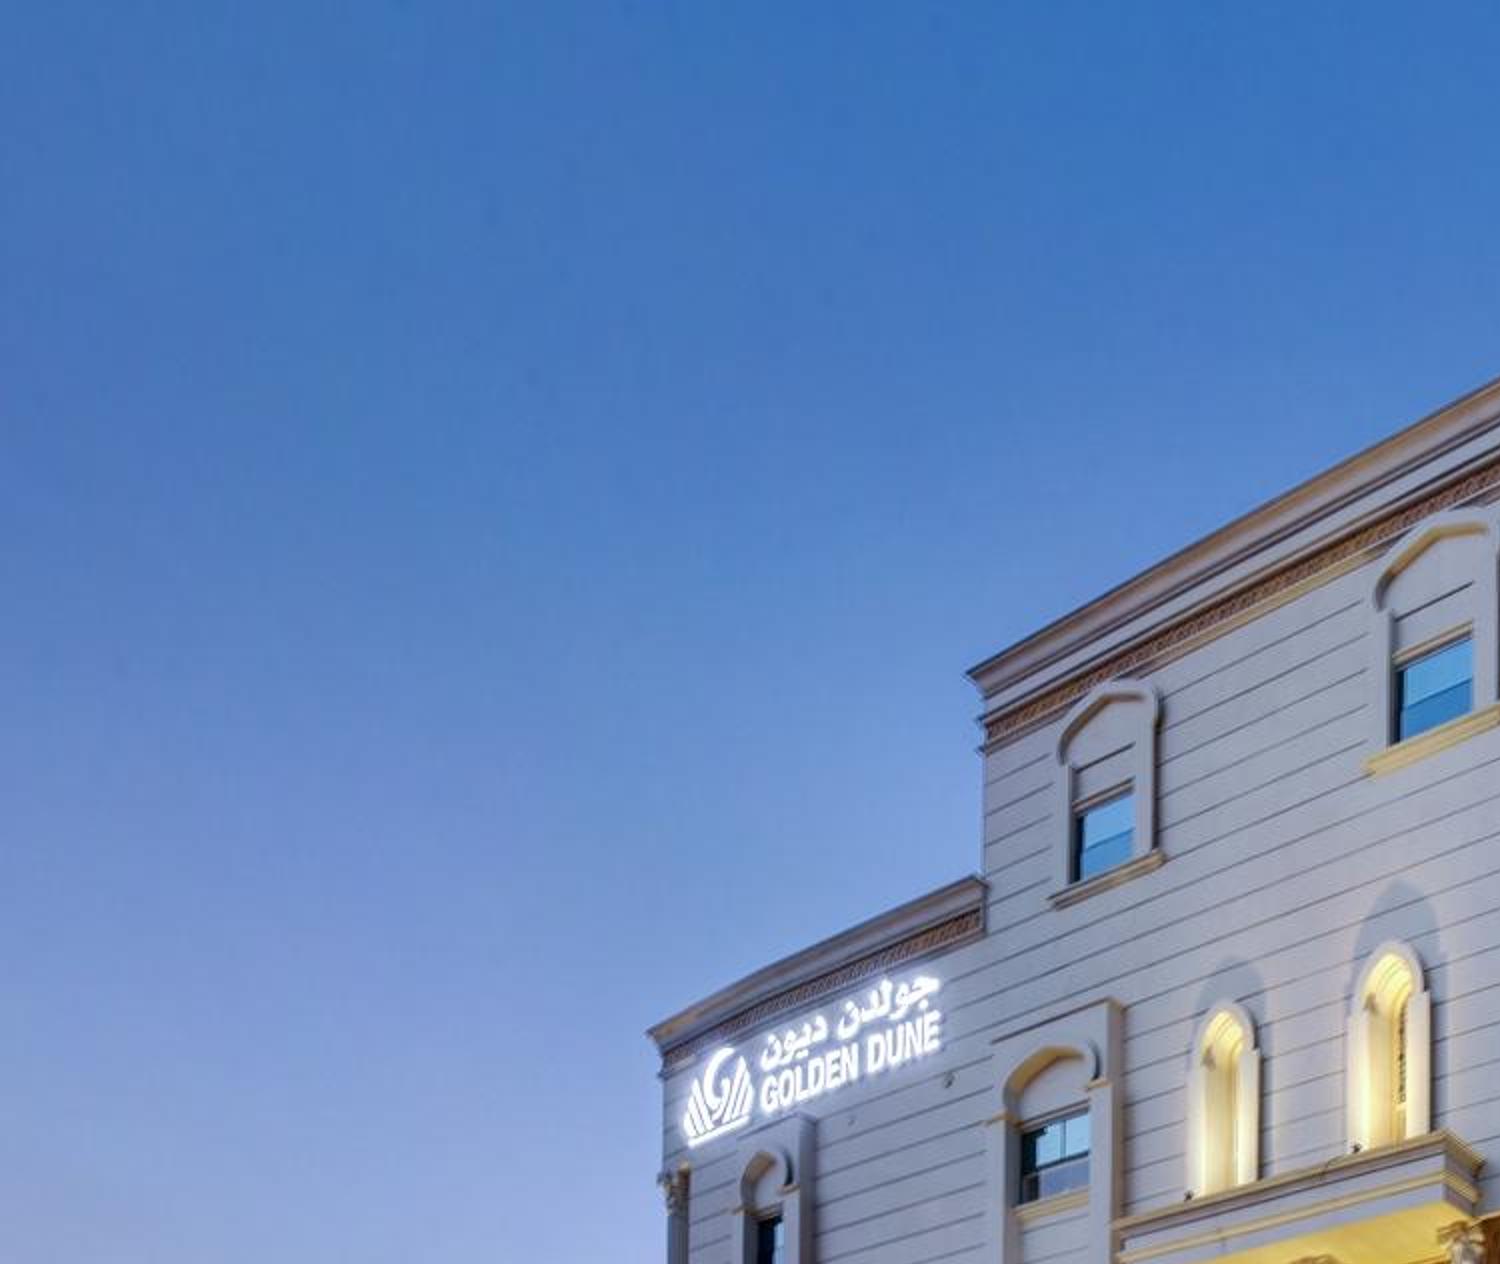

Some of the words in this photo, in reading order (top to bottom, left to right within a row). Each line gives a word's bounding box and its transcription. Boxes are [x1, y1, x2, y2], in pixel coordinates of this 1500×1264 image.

[760, 1015, 828, 1071] ديون
[760, 1041, 859, 1113] GOLDEN
[867, 1009, 941, 1074] DUNE
